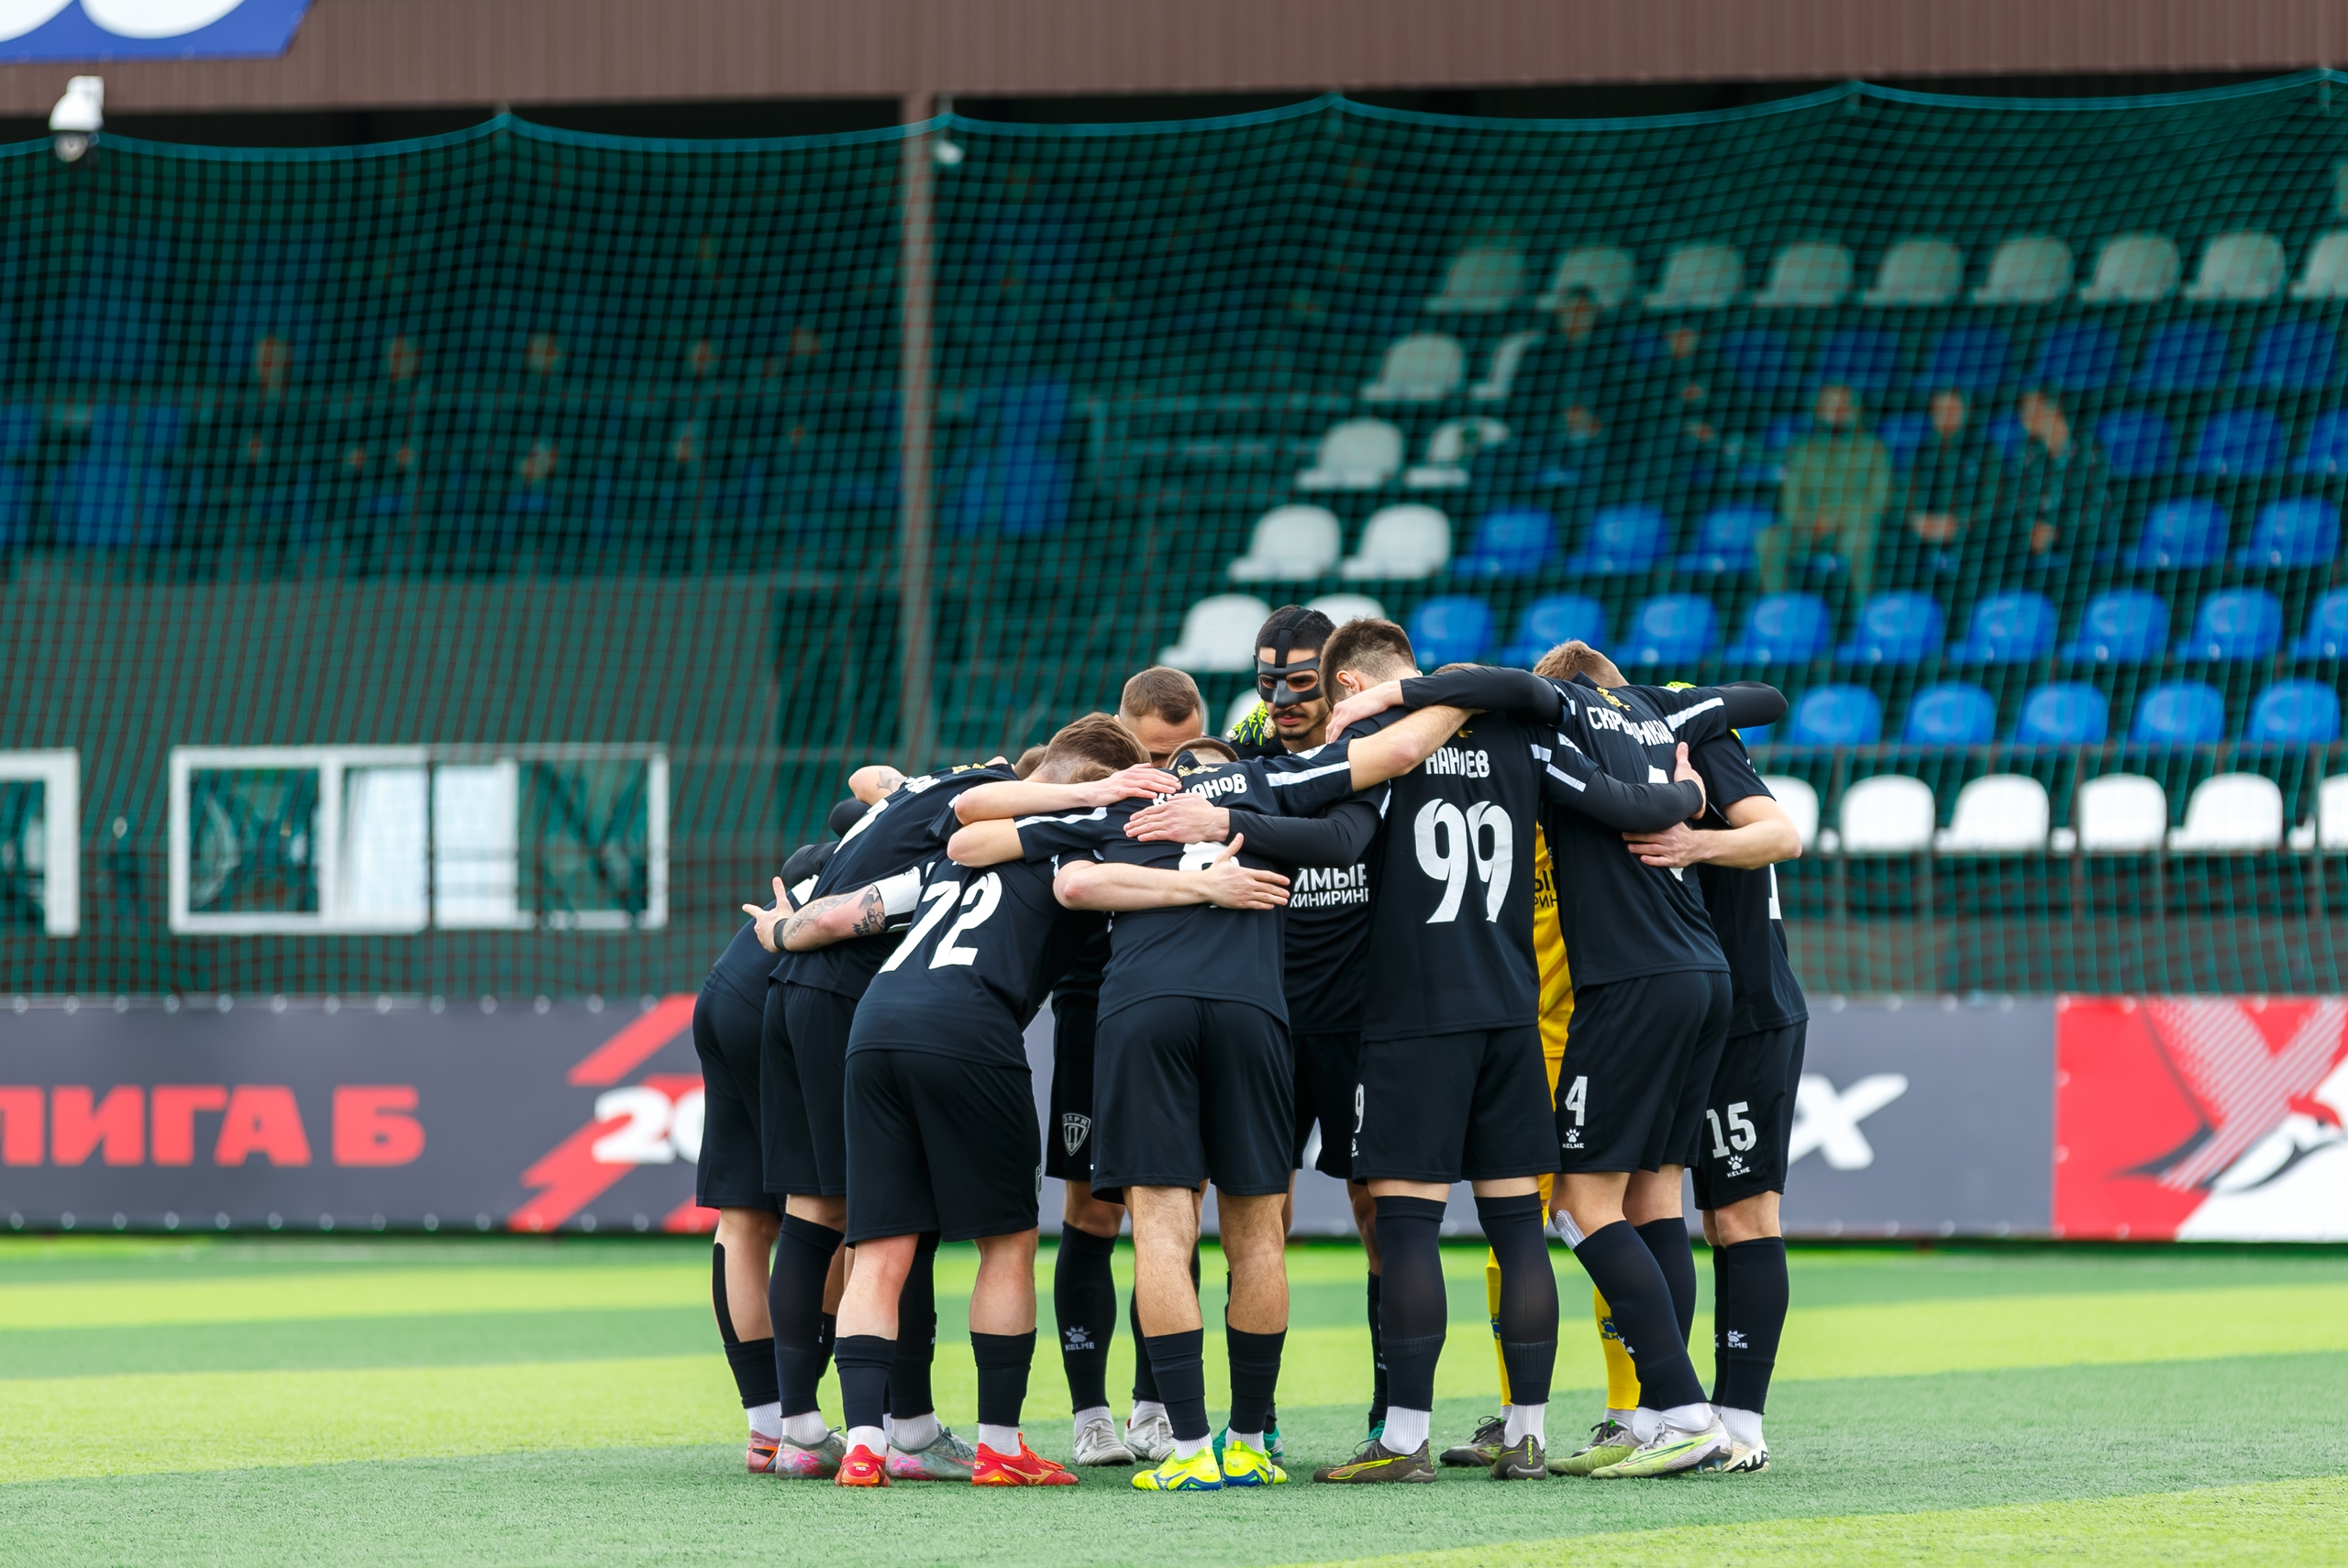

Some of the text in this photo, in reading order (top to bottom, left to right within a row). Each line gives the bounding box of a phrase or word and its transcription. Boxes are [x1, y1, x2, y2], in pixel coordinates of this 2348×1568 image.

[1413, 798, 1513, 923] 99
[878, 871, 1002, 975] 72
[331, 1084, 426, 1167] Б
[1565, 1076, 1588, 1126] 4
[1706, 1101, 1756, 1158] 15
[1727, 1166, 1751, 1178] KELME
[1065, 1342, 1095, 1352] KELME
